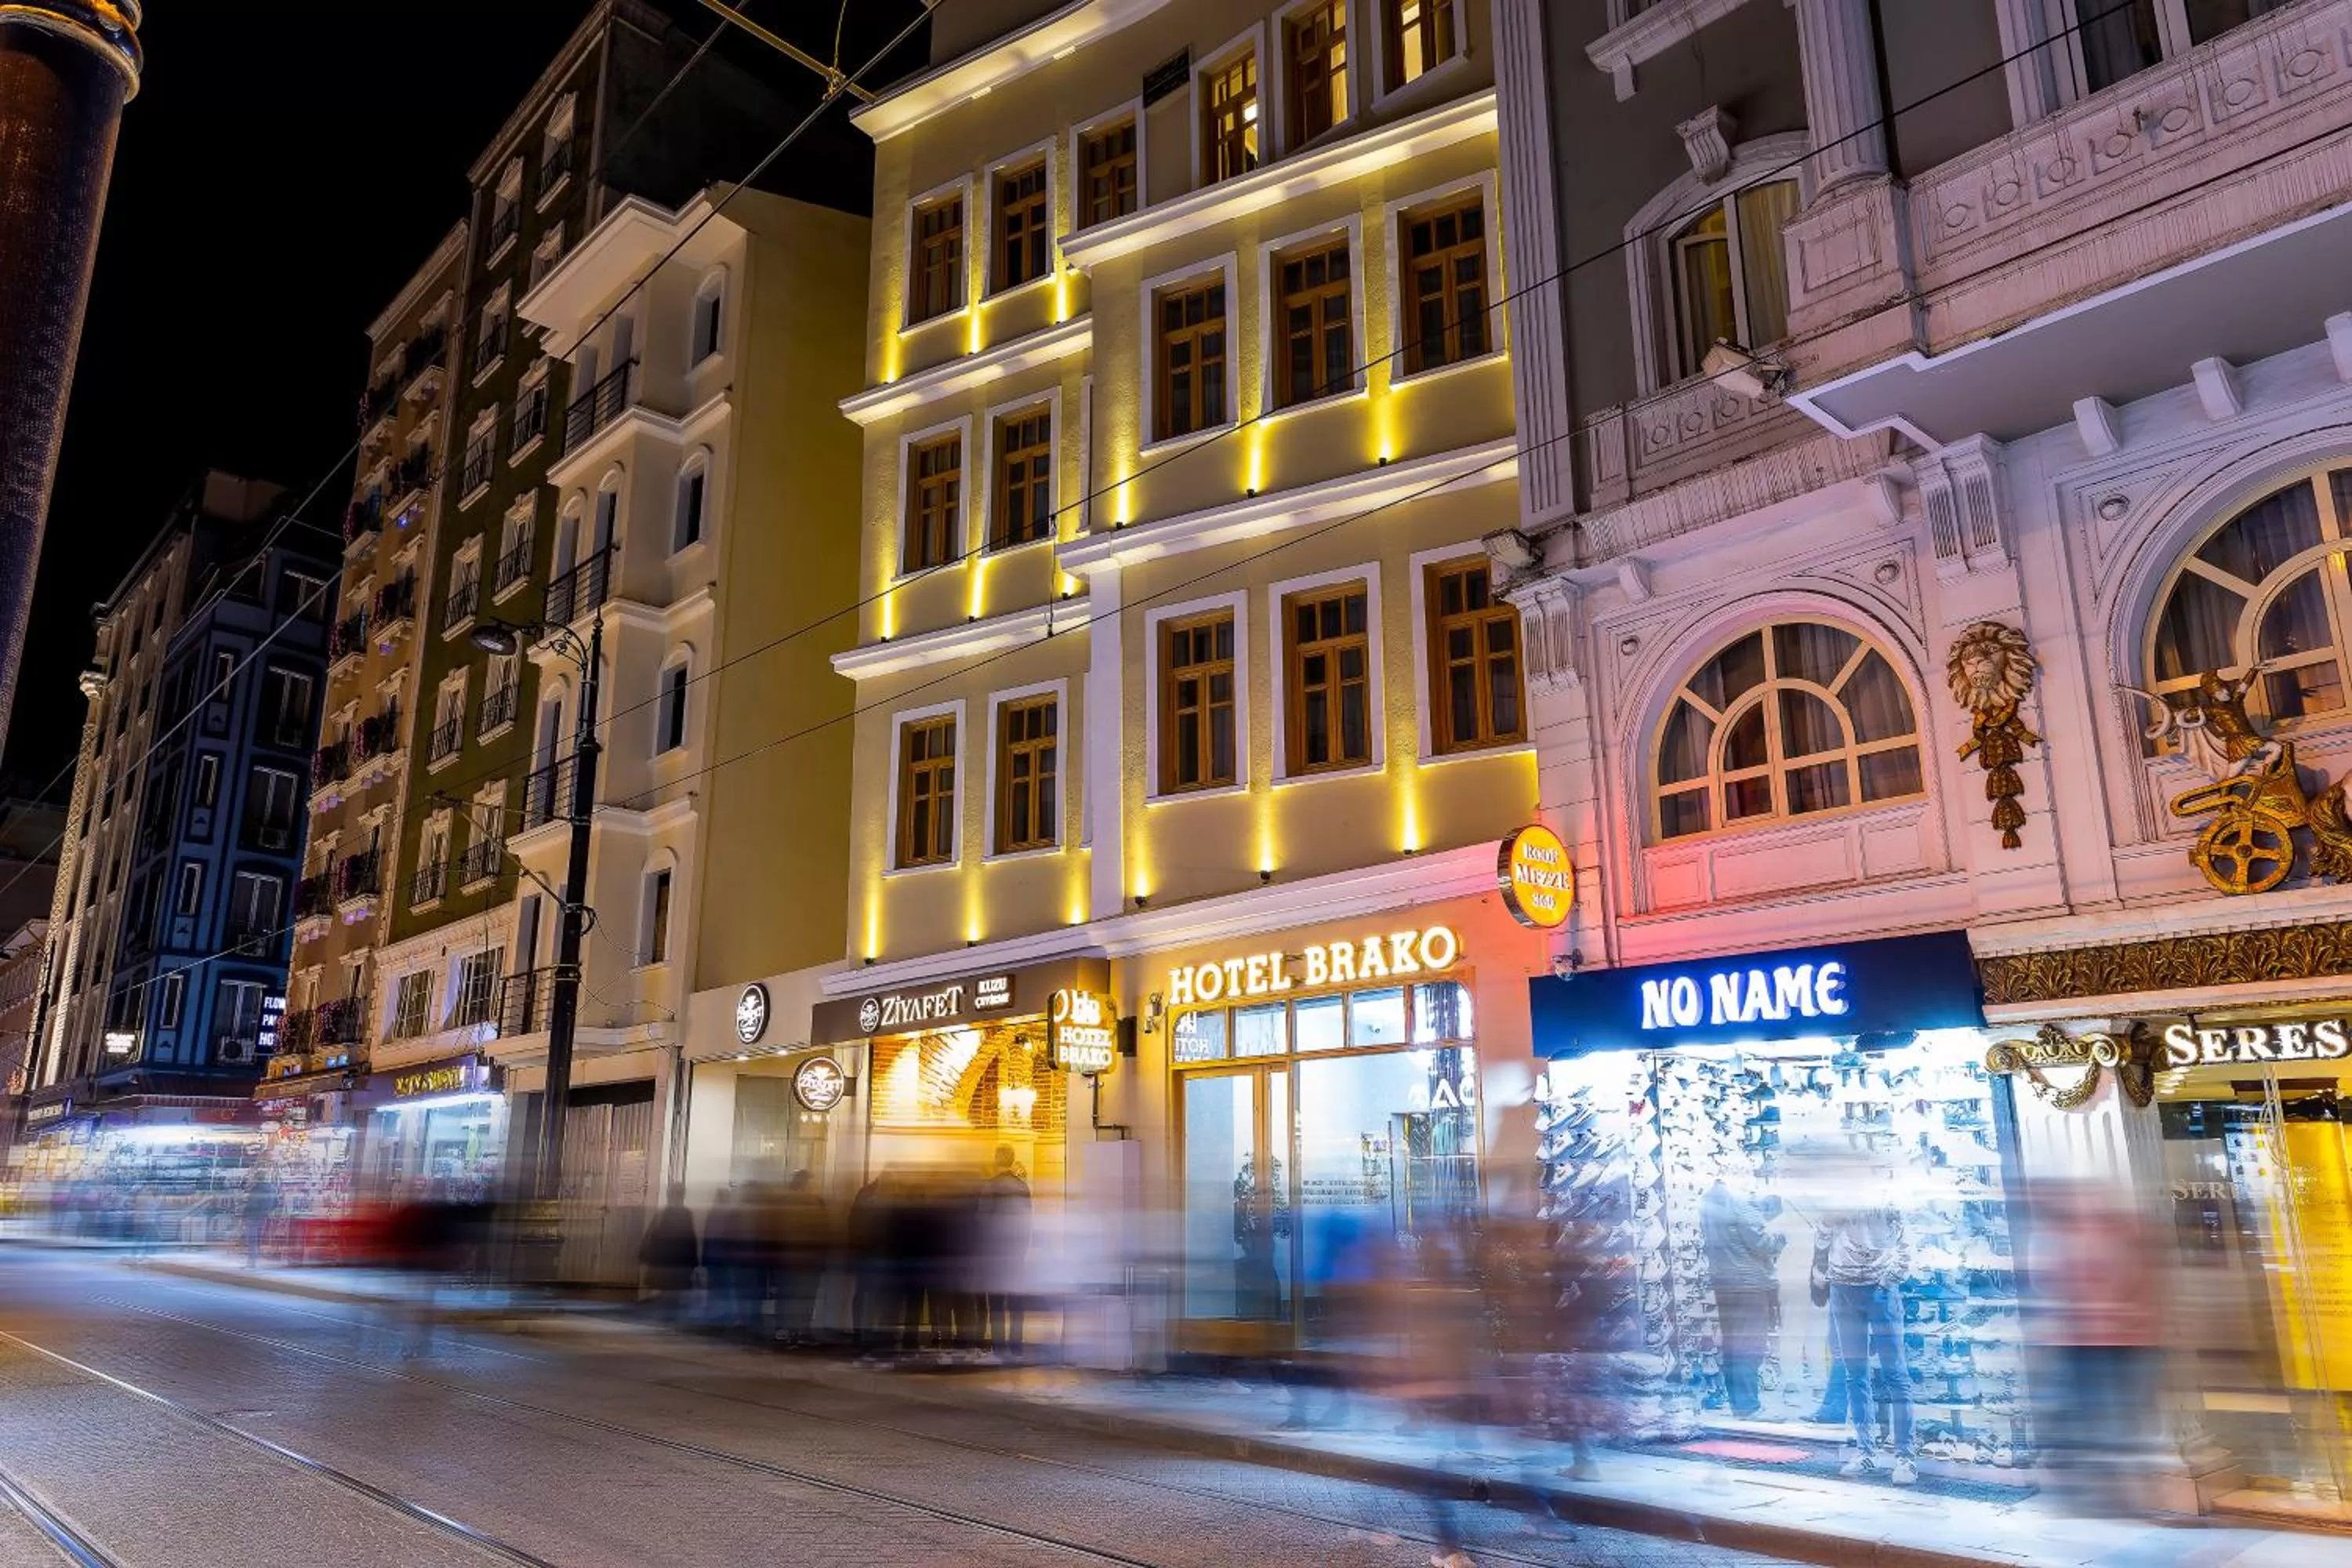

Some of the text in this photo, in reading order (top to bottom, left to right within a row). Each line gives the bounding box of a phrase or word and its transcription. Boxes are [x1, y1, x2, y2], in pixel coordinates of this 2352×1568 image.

[1169, 926, 1456, 1004] HOTEL BRAKO
[880, 985, 964, 1026] ZİYAFET
[1641, 962, 1849, 1029] NO NAME
[258, 1032, 274, 1045] HO
[1059, 1026, 1112, 1047] HOTEL
[2164, 1019, 2348, 1065] SERES
